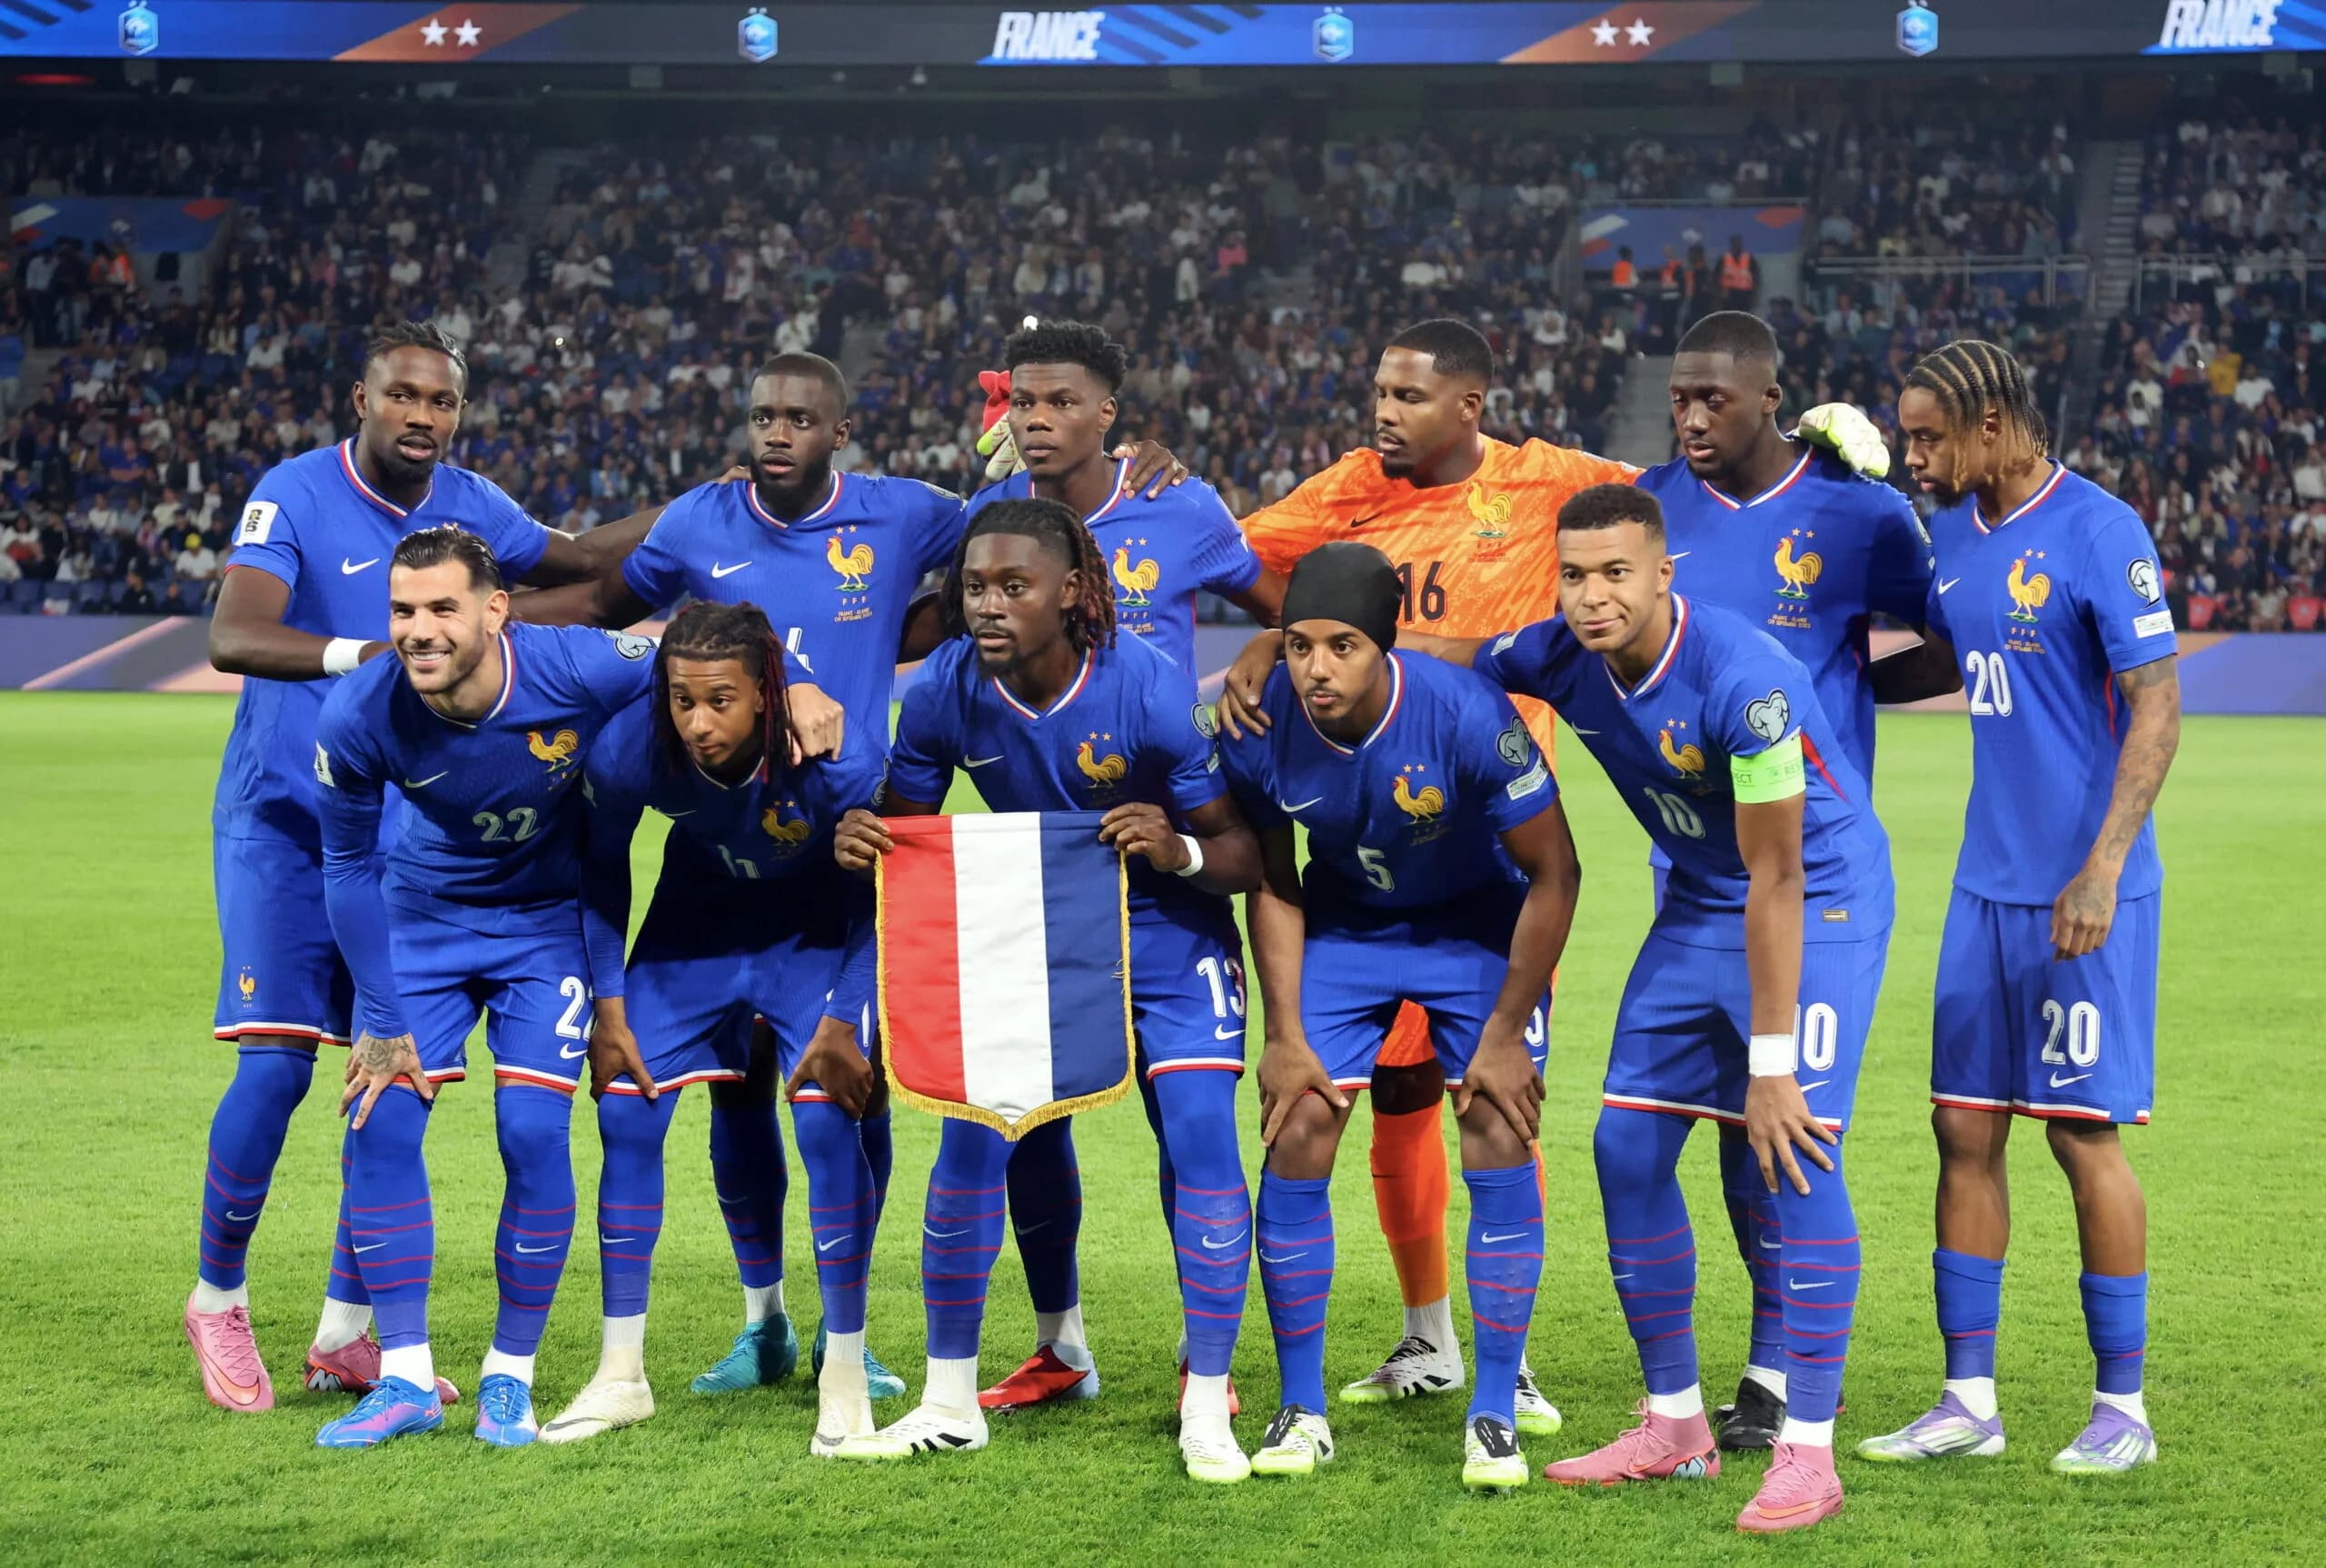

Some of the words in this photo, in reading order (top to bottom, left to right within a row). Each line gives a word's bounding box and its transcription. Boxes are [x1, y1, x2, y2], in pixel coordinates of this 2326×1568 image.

[991, 11, 1106, 60] FRANCE
[2159, 0, 2283, 48] FRANCE
[1396, 561, 1447, 624] 16
[1966, 650, 2013, 717] 20
[472, 807, 539, 842] 22
[1643, 787, 1706, 839] 10
[1357, 844, 1395, 893] 5
[1196, 957, 1246, 1018] 13
[2042, 998, 2101, 1067] 20
